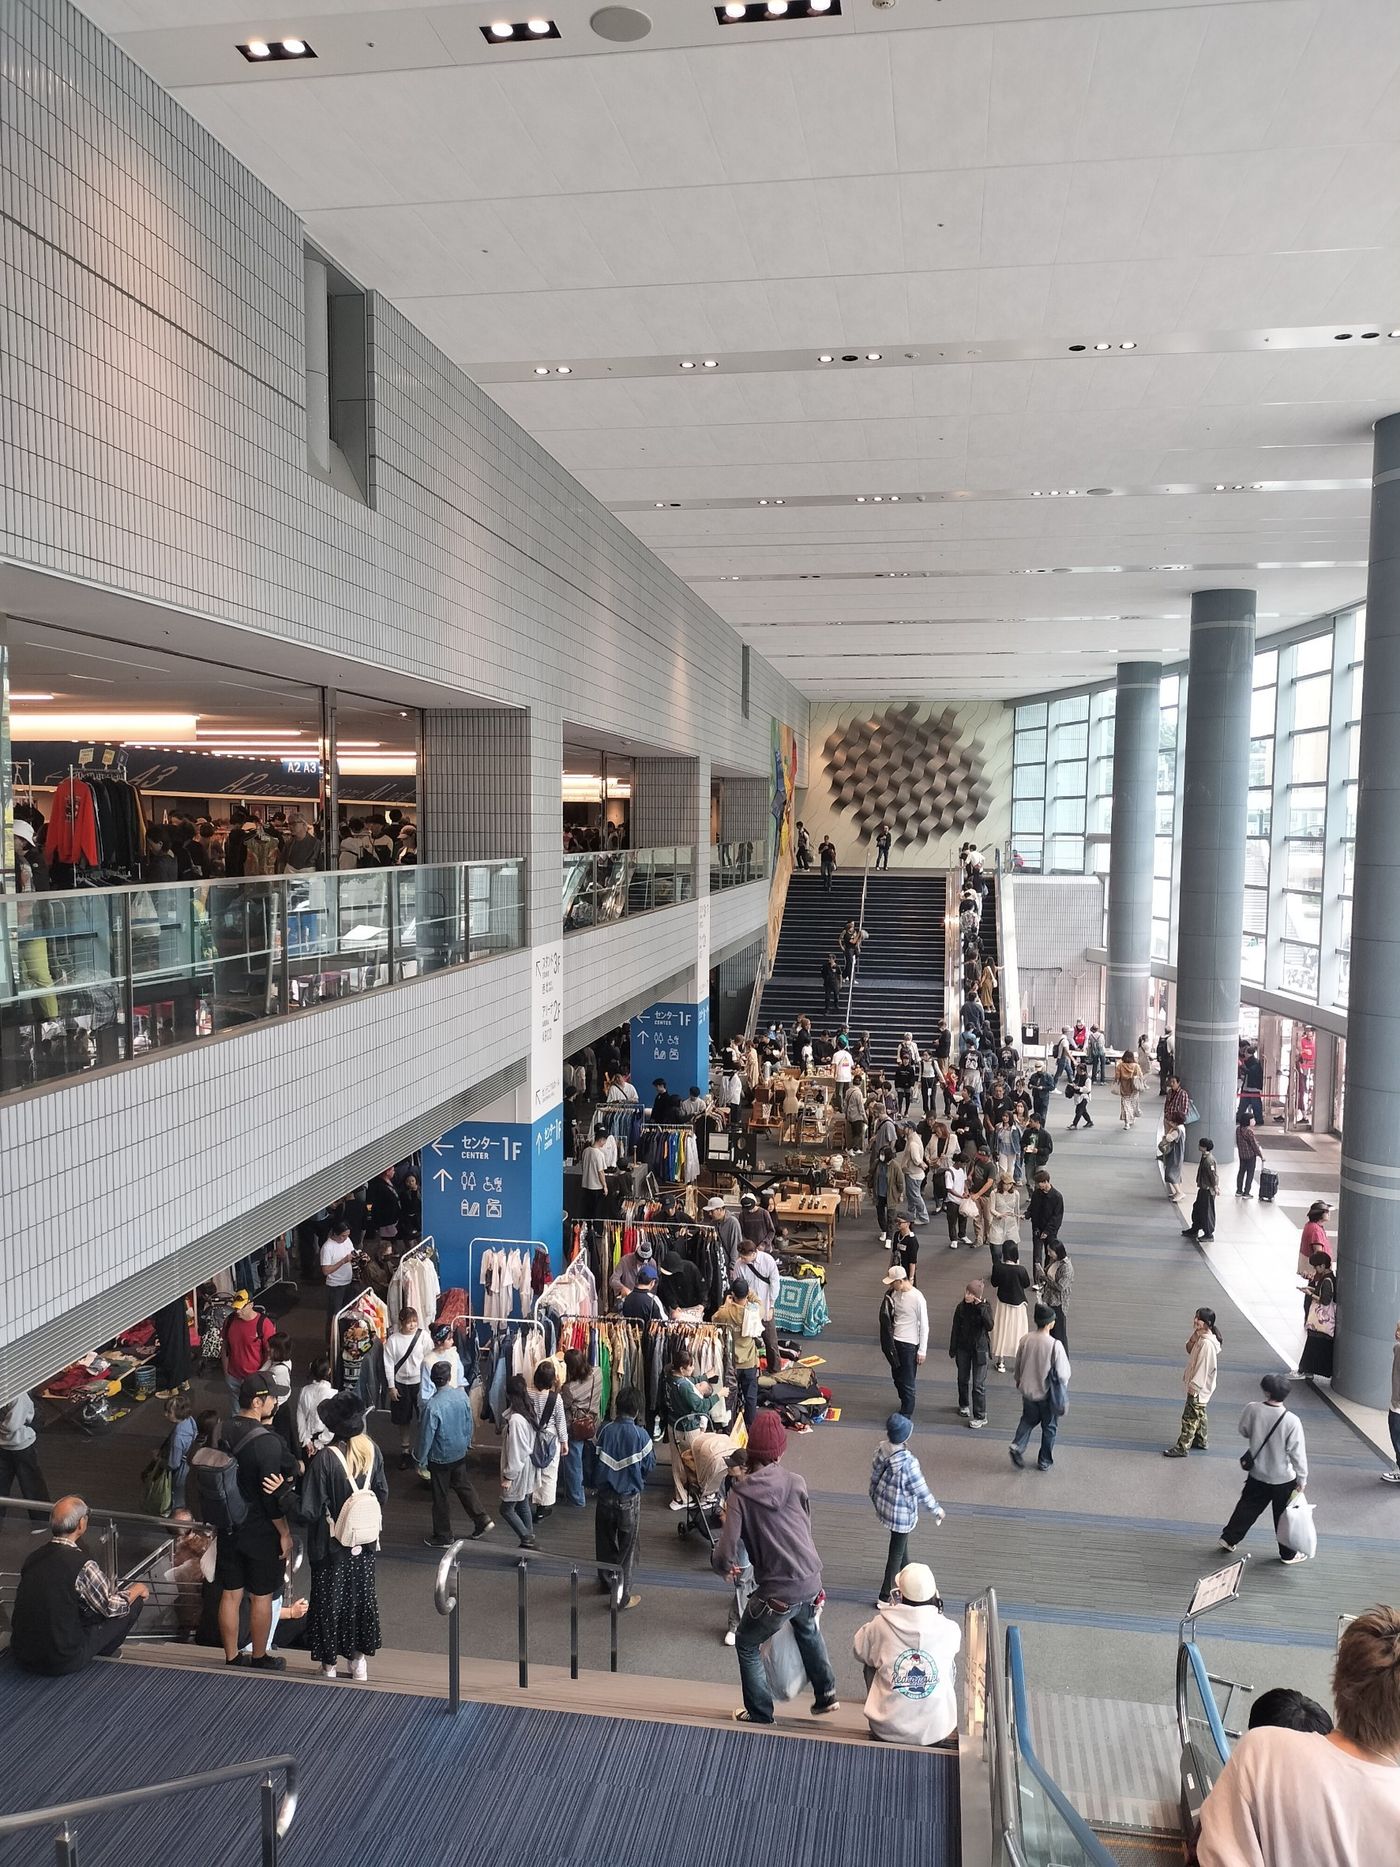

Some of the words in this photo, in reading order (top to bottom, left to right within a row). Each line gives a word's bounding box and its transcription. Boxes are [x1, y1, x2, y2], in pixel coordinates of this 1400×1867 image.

[287, 761, 301, 773] A2
[303, 761, 317, 773] A3
[218, 772, 269, 793] A2
[553, 1000, 561, 1022] 2F
[655, 1010, 678, 1020] センター
[679, 1011, 691, 1026] 1F
[461, 1135, 500, 1150] センター
[502, 1136, 522, 1161] 1F
[461, 1151, 489, 1160] CENTER
